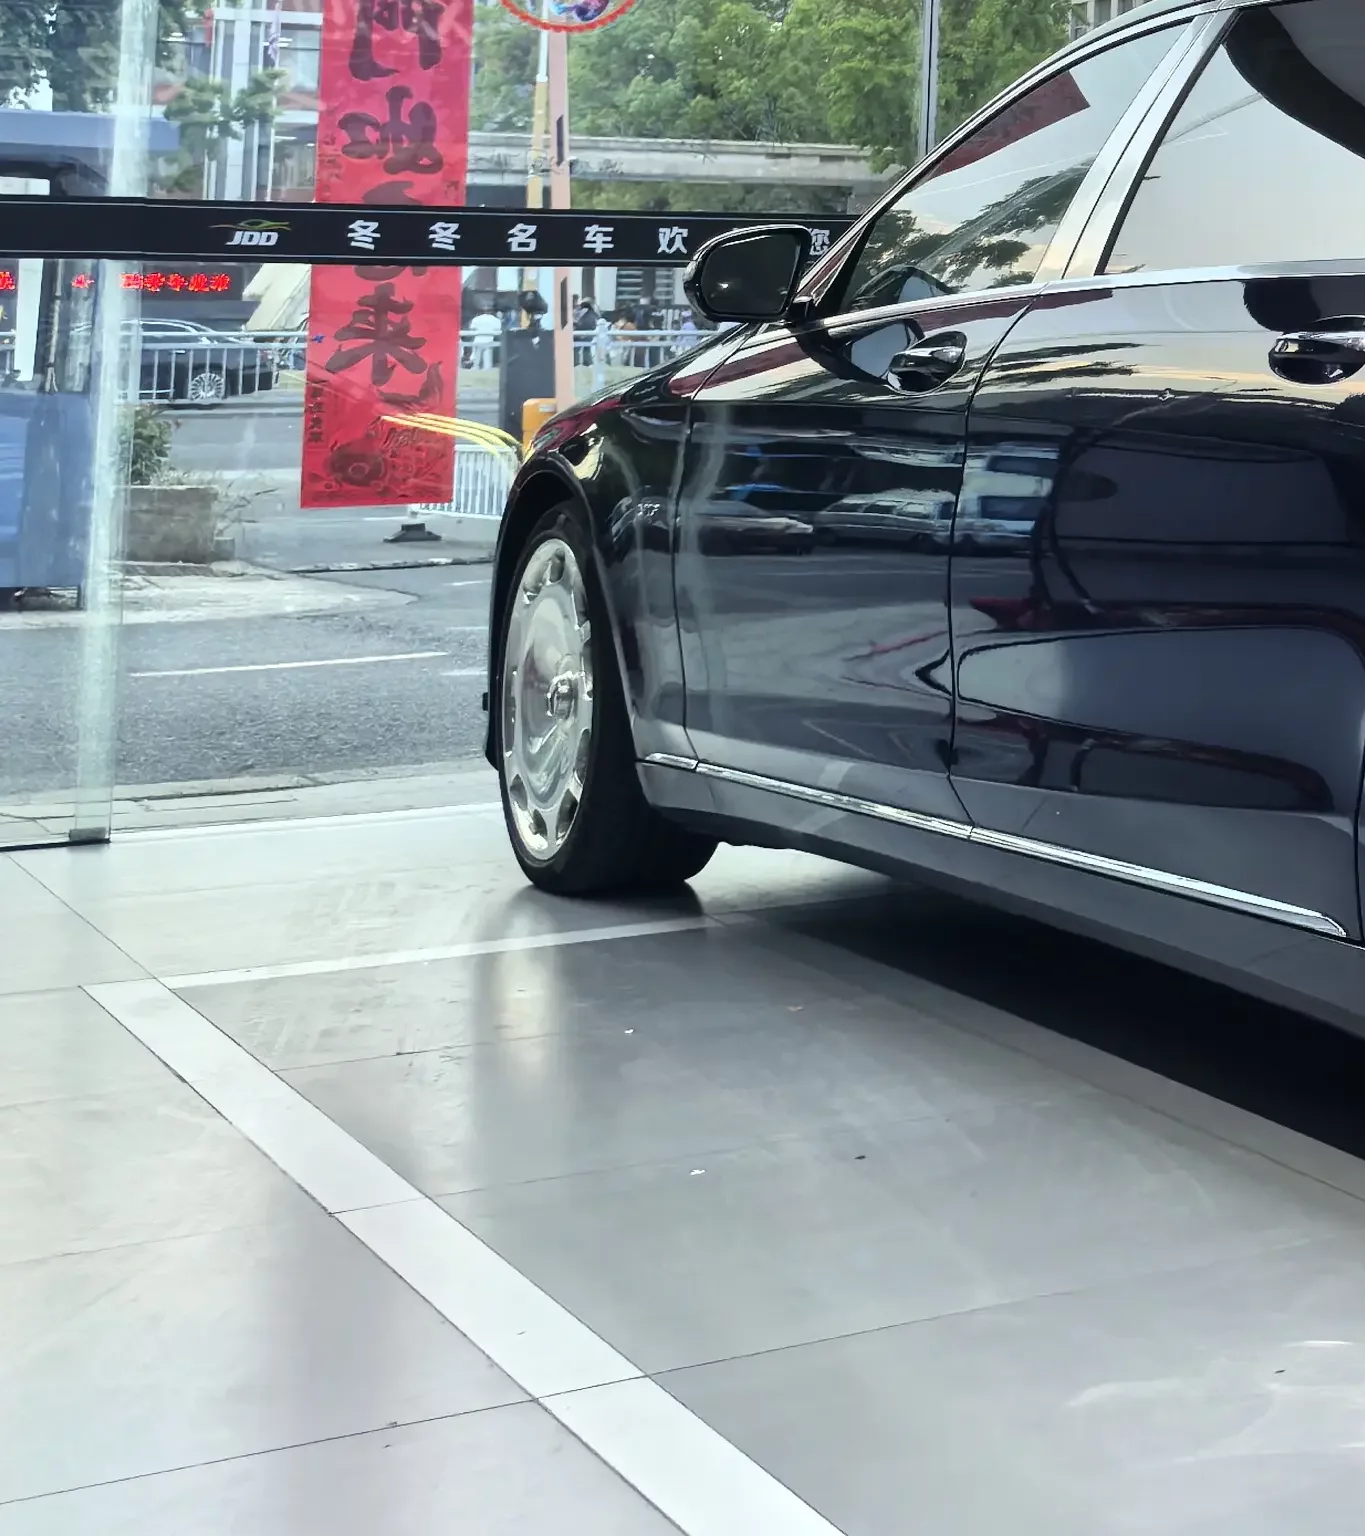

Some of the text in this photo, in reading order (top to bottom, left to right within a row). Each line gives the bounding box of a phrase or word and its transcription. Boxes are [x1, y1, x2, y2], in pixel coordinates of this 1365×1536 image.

[225, 231, 279, 247] JDD
[347, 219, 830, 257] 冬冬名车欢您
